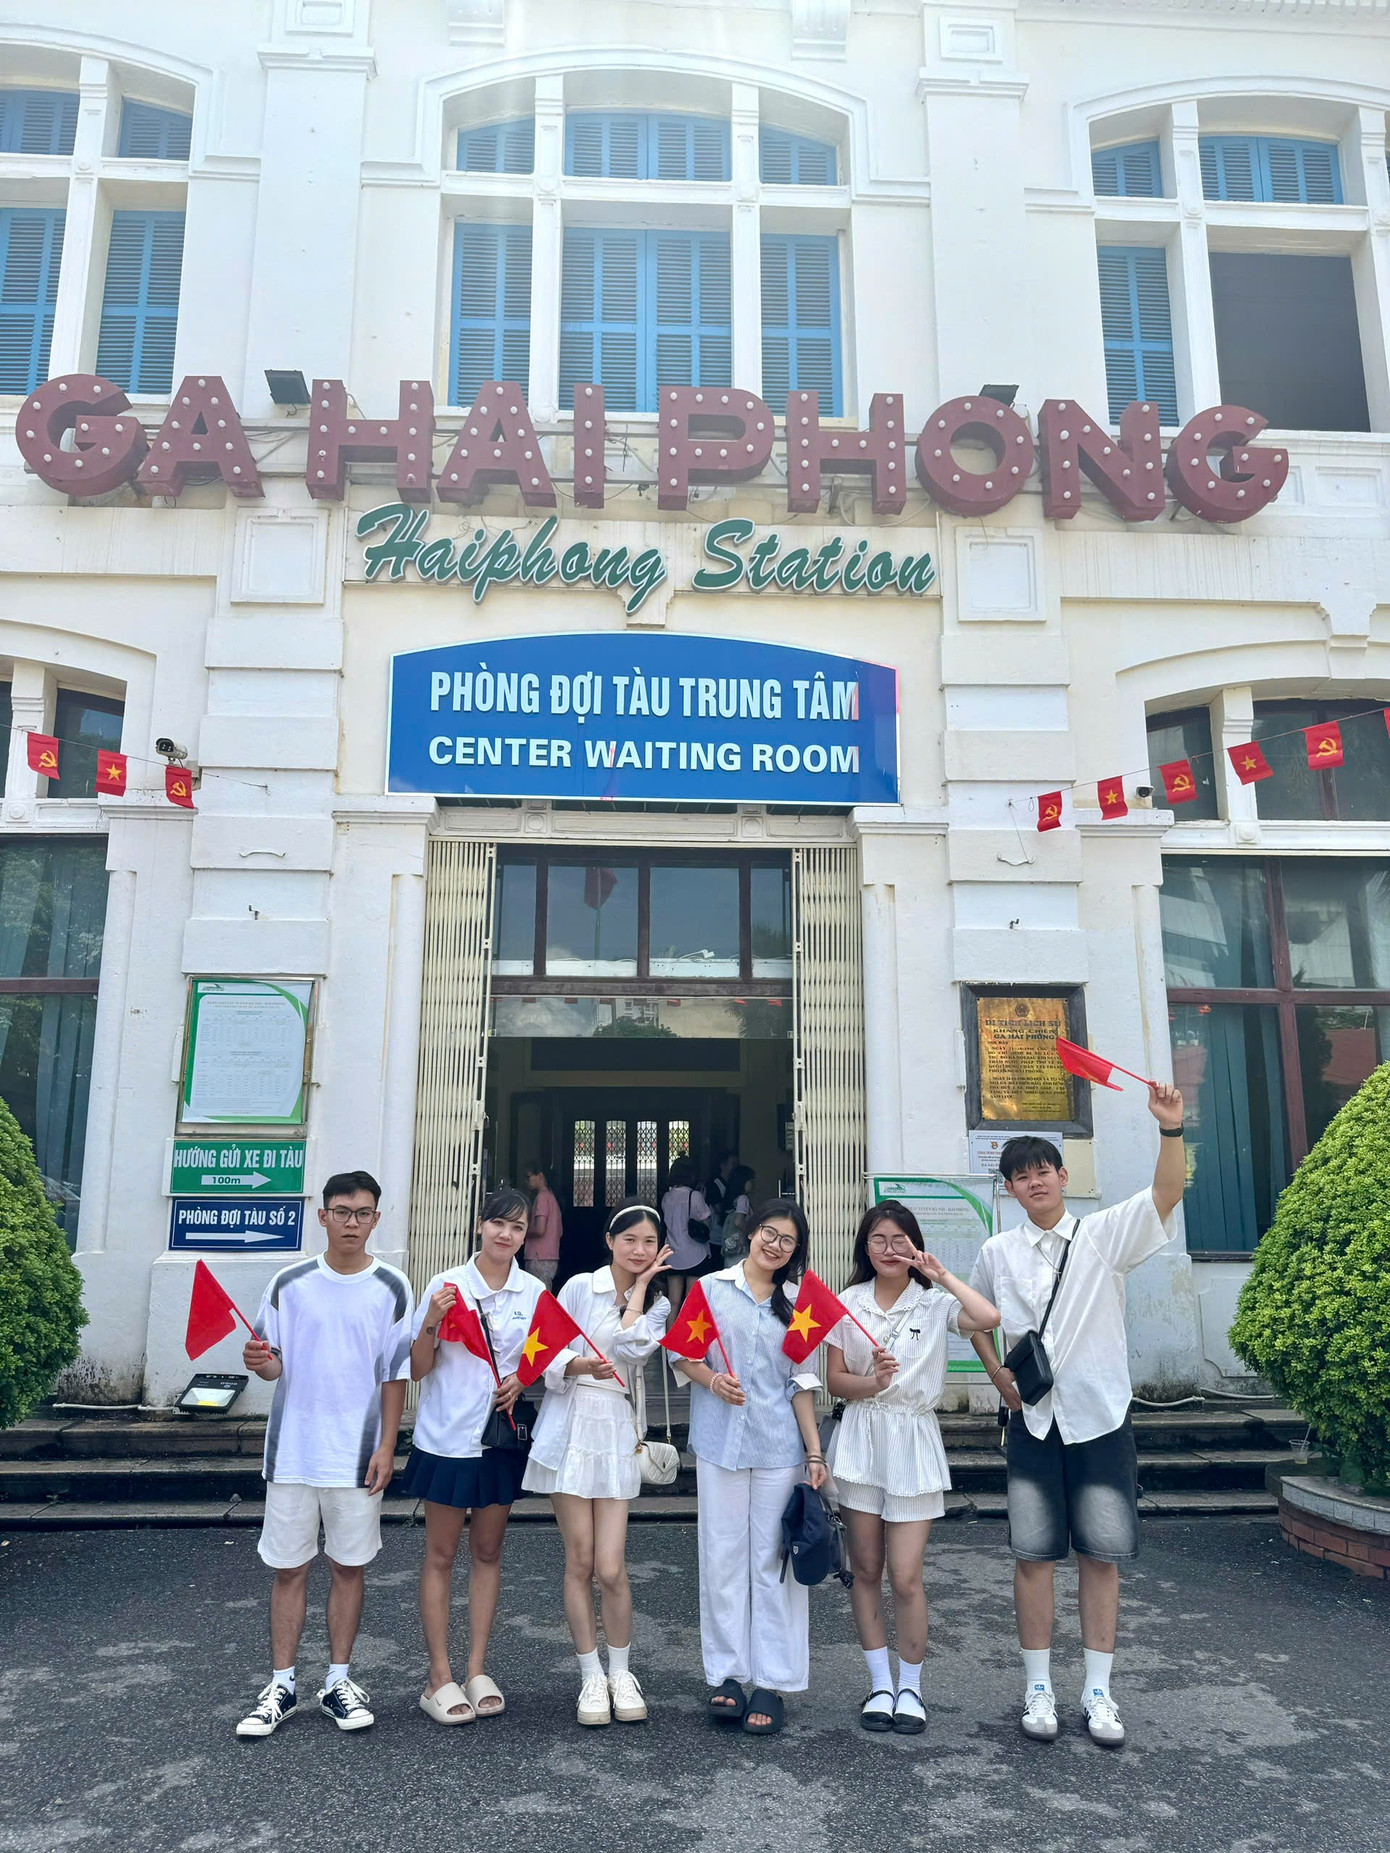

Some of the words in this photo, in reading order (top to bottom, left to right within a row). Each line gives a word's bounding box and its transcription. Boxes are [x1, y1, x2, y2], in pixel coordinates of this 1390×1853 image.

[15, 373, 265, 498] GA
[356, 502, 667, 615] Haiphong
[692, 517, 935, 593] Station
[430, 662, 540, 713] PHÒNG
[550, 671, 602, 724] ĐỢI
[613, 666, 670, 717] TÀU
[679, 677, 782, 719] TRUNG
[793, 671, 860, 721] TÂM
[429, 736, 572, 768] CENTER
[585, 740, 742, 772] WAITING
[753, 743, 860, 774] ROOM
[174, 1146, 217, 1168] HƯỚNG
[220, 1144, 241, 1168] GỬI
[243, 1150, 260, 1168] XE
[263, 1150, 276, 1168] ĐI
[280, 1146, 303, 1168] TÀU
[212, 1176, 241, 1184] 100m
[178, 1206, 218, 1225] PHÒNG
[221, 1209, 241, 1228] ĐỢI
[244, 1207, 266, 1226] TÀU
[269, 1206, 286, 1226] SỐ
[287, 1211, 296, 1226] 2
